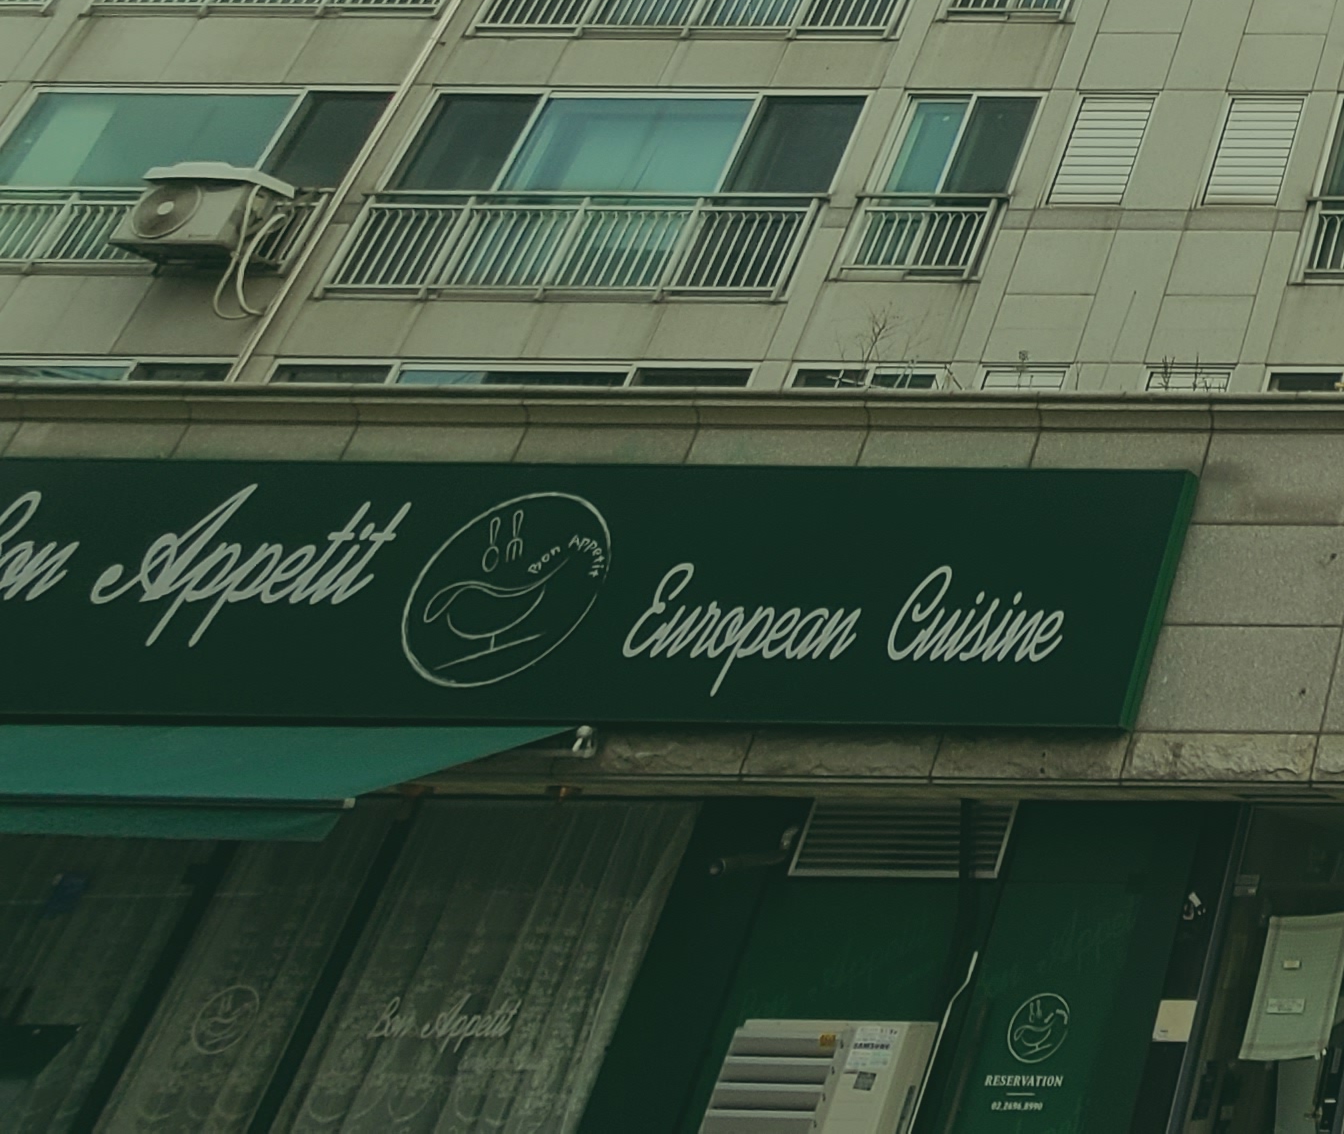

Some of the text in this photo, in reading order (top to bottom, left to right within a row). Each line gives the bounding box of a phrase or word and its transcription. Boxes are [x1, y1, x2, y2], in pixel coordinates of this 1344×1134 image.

[90, 483, 412, 648] Appetit
[622, 562, 1067, 698] European Cuisine
[420, 992, 523, 1054] Appetit
[984, 1074, 1064, 1087] RESERVATION
